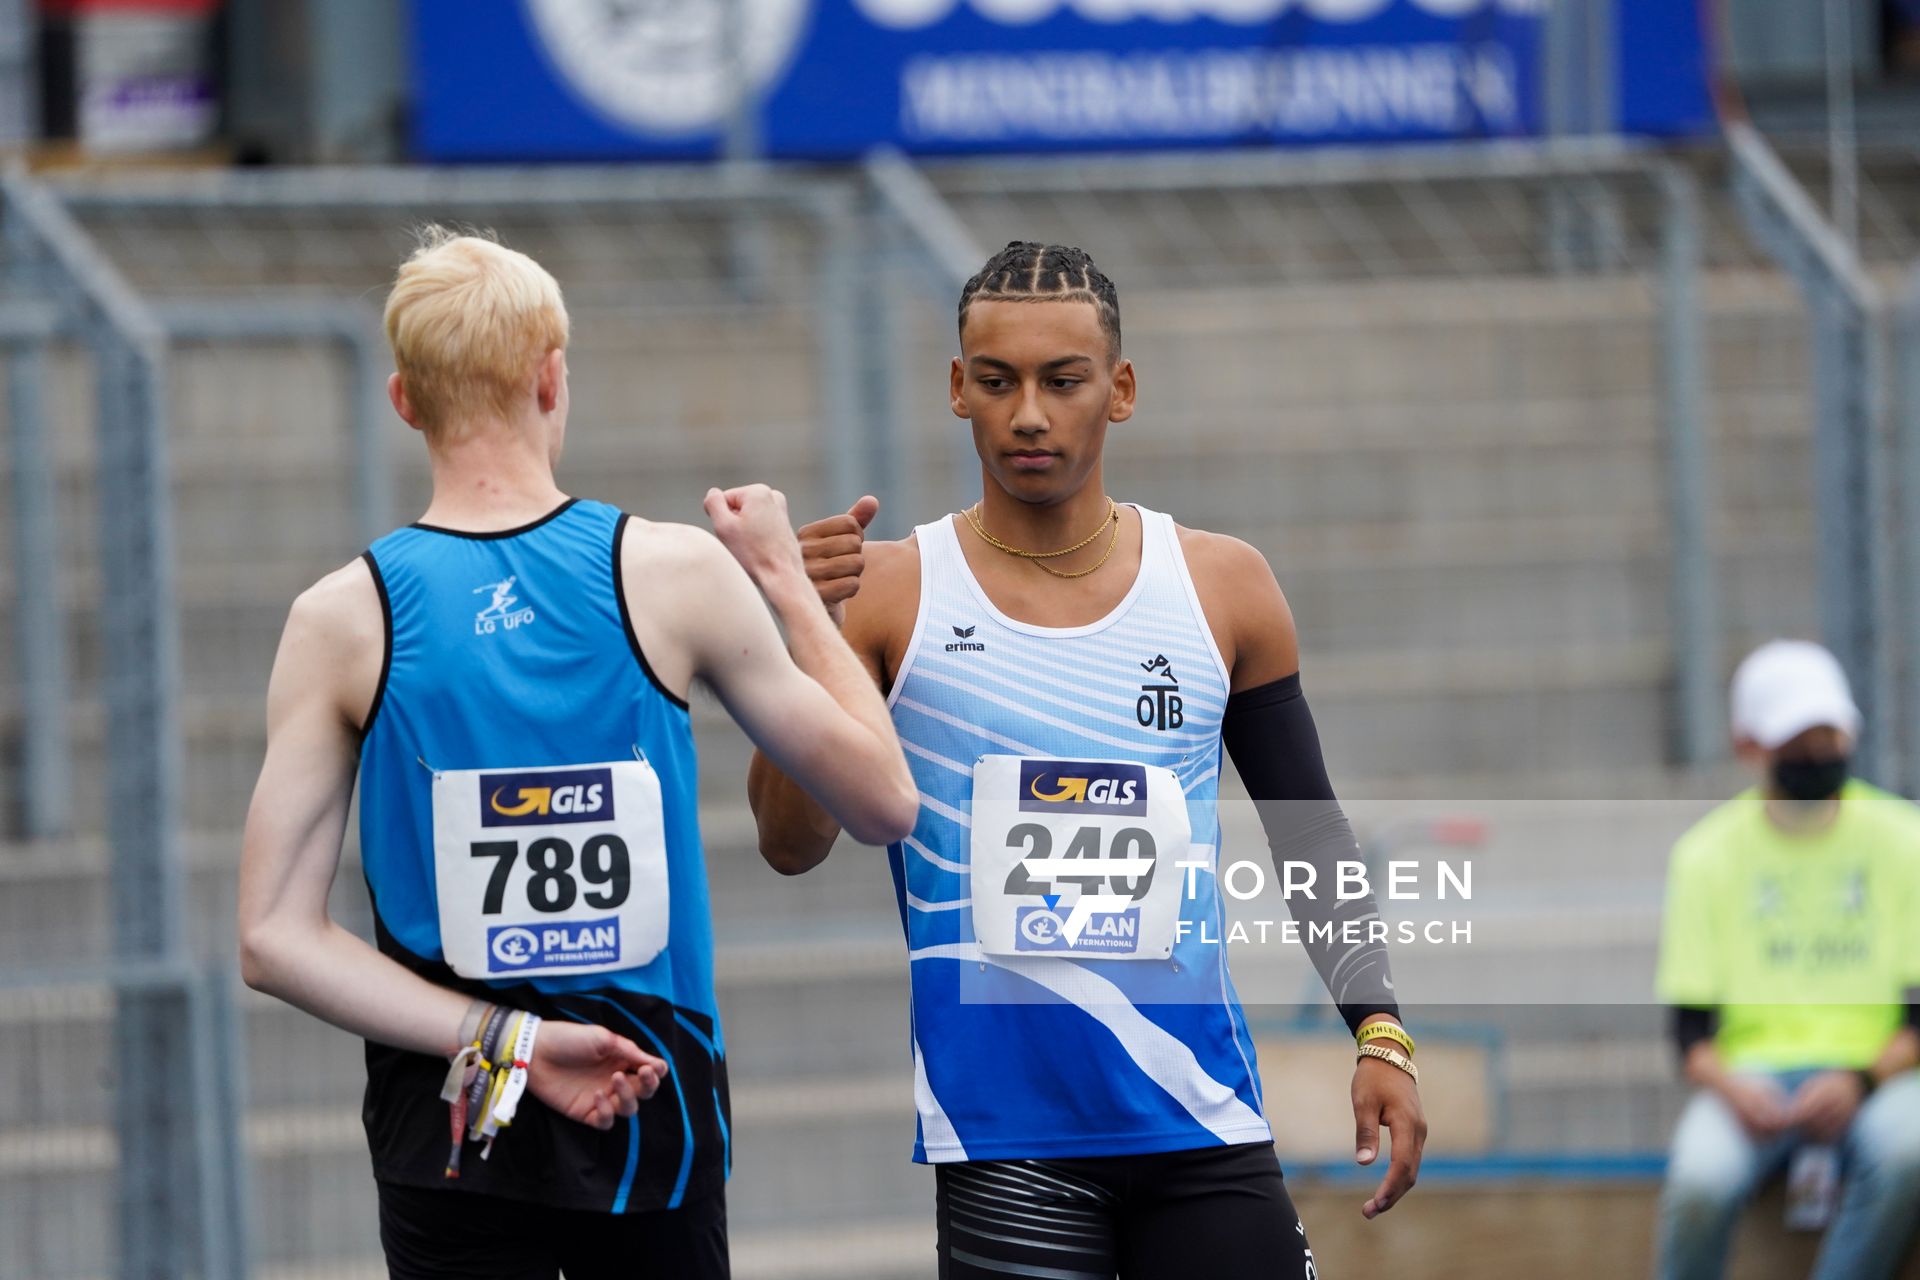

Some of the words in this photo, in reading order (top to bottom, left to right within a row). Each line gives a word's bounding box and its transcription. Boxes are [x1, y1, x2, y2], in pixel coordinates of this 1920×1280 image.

[475, 619, 496, 635] LG
[503, 609, 535, 630] UFO
[945, 641, 985, 652] erima
[1136, 685, 1183, 731] OTB
[551, 784, 603, 814] GLS
[1087, 779, 1137, 805] GLS
[470, 833, 631, 915] 789
[1003, 822, 1157, 901] 240
[543, 926, 615, 952] PLAN
[1085, 917, 1135, 937] LAN
[1074, 938, 1133, 948] TERNATIONAL
[543, 950, 615, 963] INTERNATIONAL
